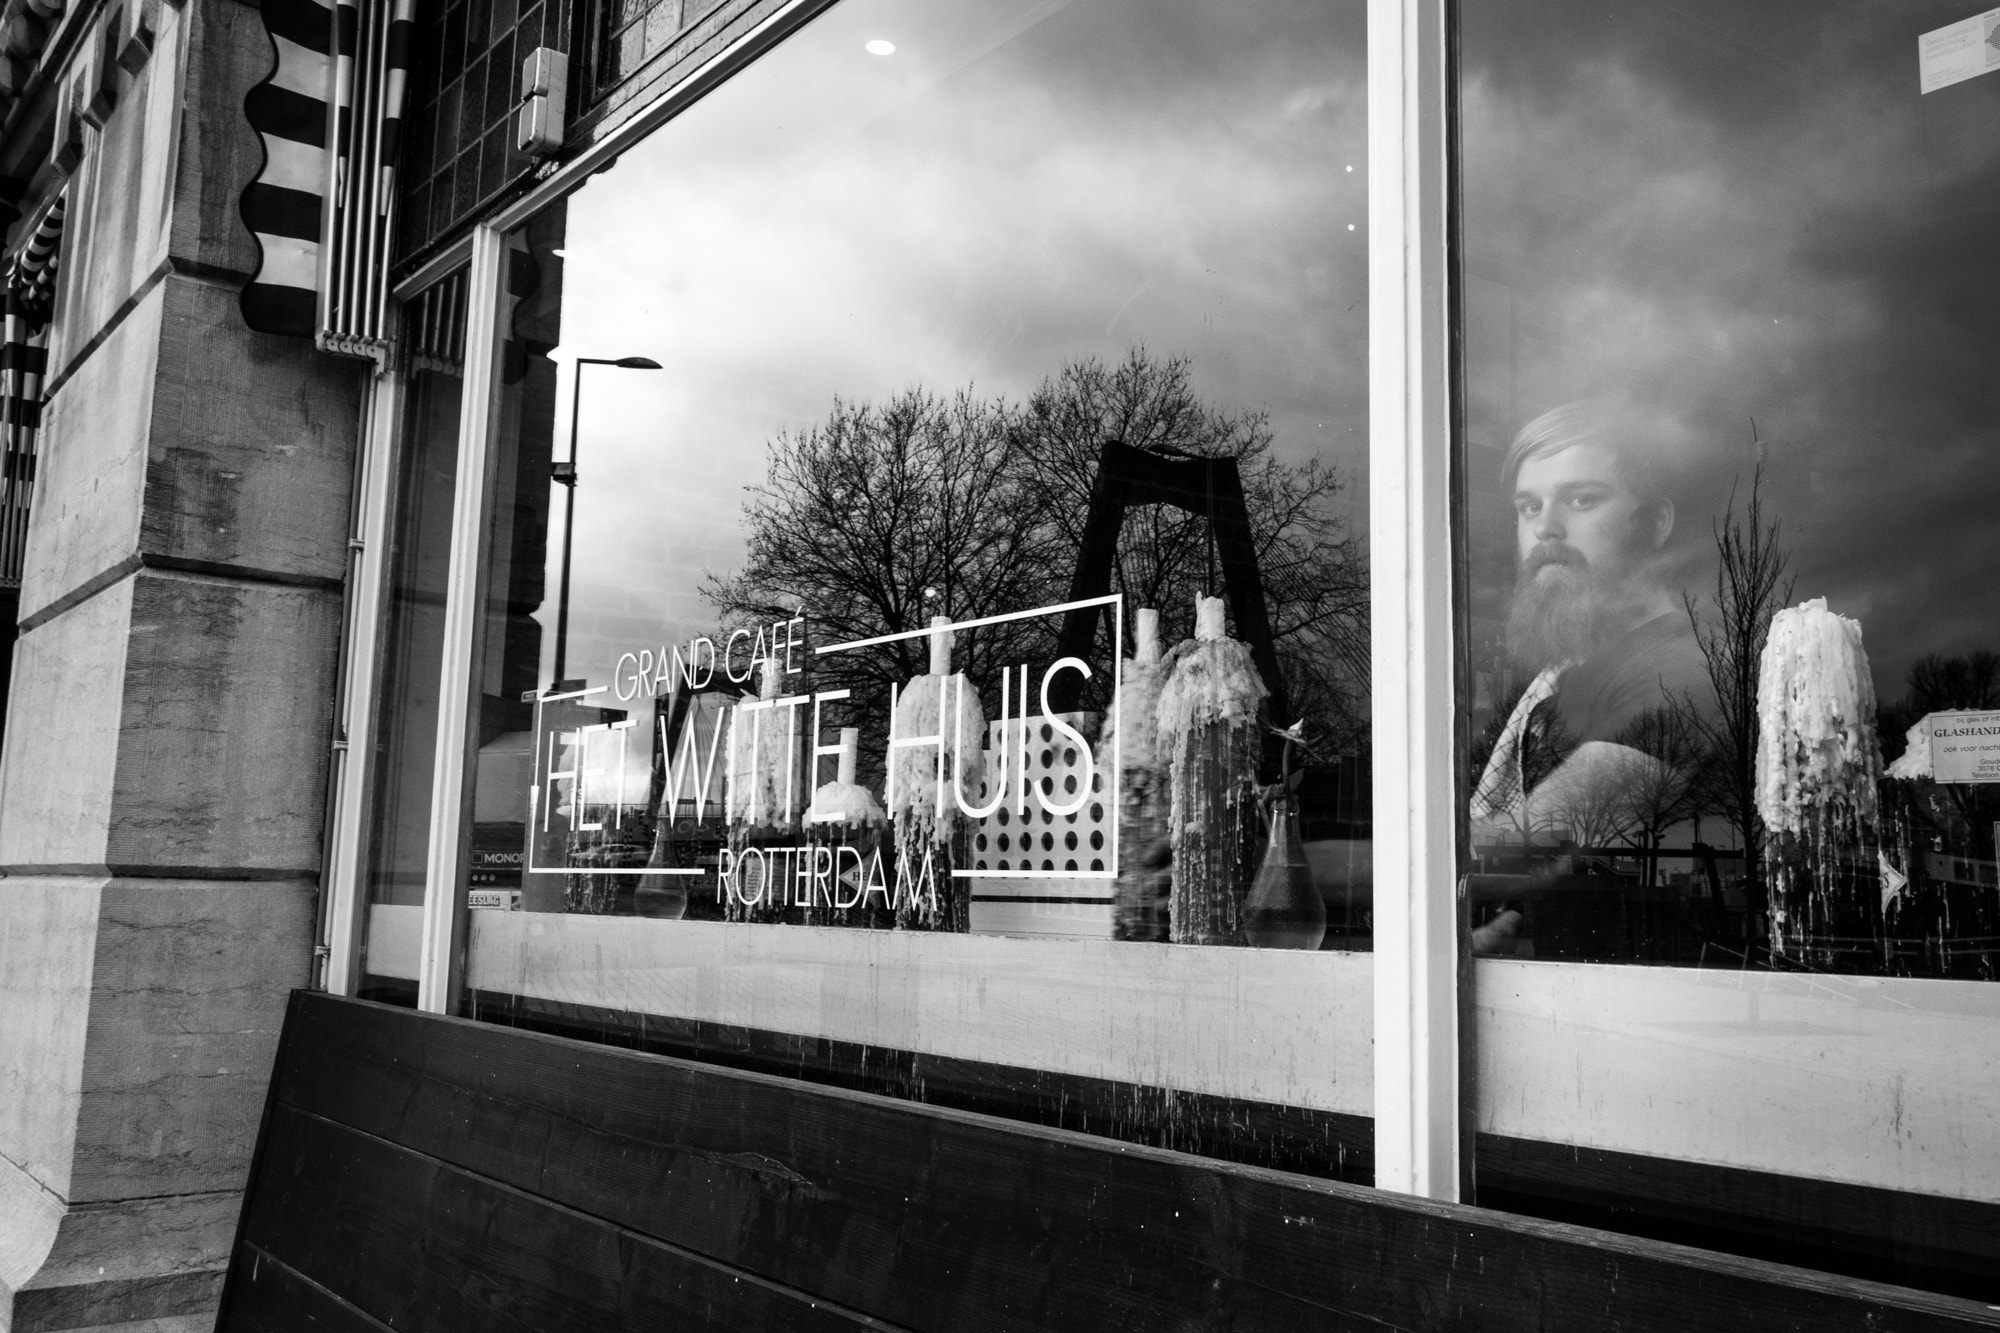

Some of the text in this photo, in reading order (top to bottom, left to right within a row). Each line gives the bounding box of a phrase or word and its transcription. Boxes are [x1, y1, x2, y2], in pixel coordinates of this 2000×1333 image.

[614, 605, 805, 702] GRAND CAFÉ
[543, 656, 1094, 833] HET WITTE HUIS
[716, 845, 939, 912] ROTTERDAM
